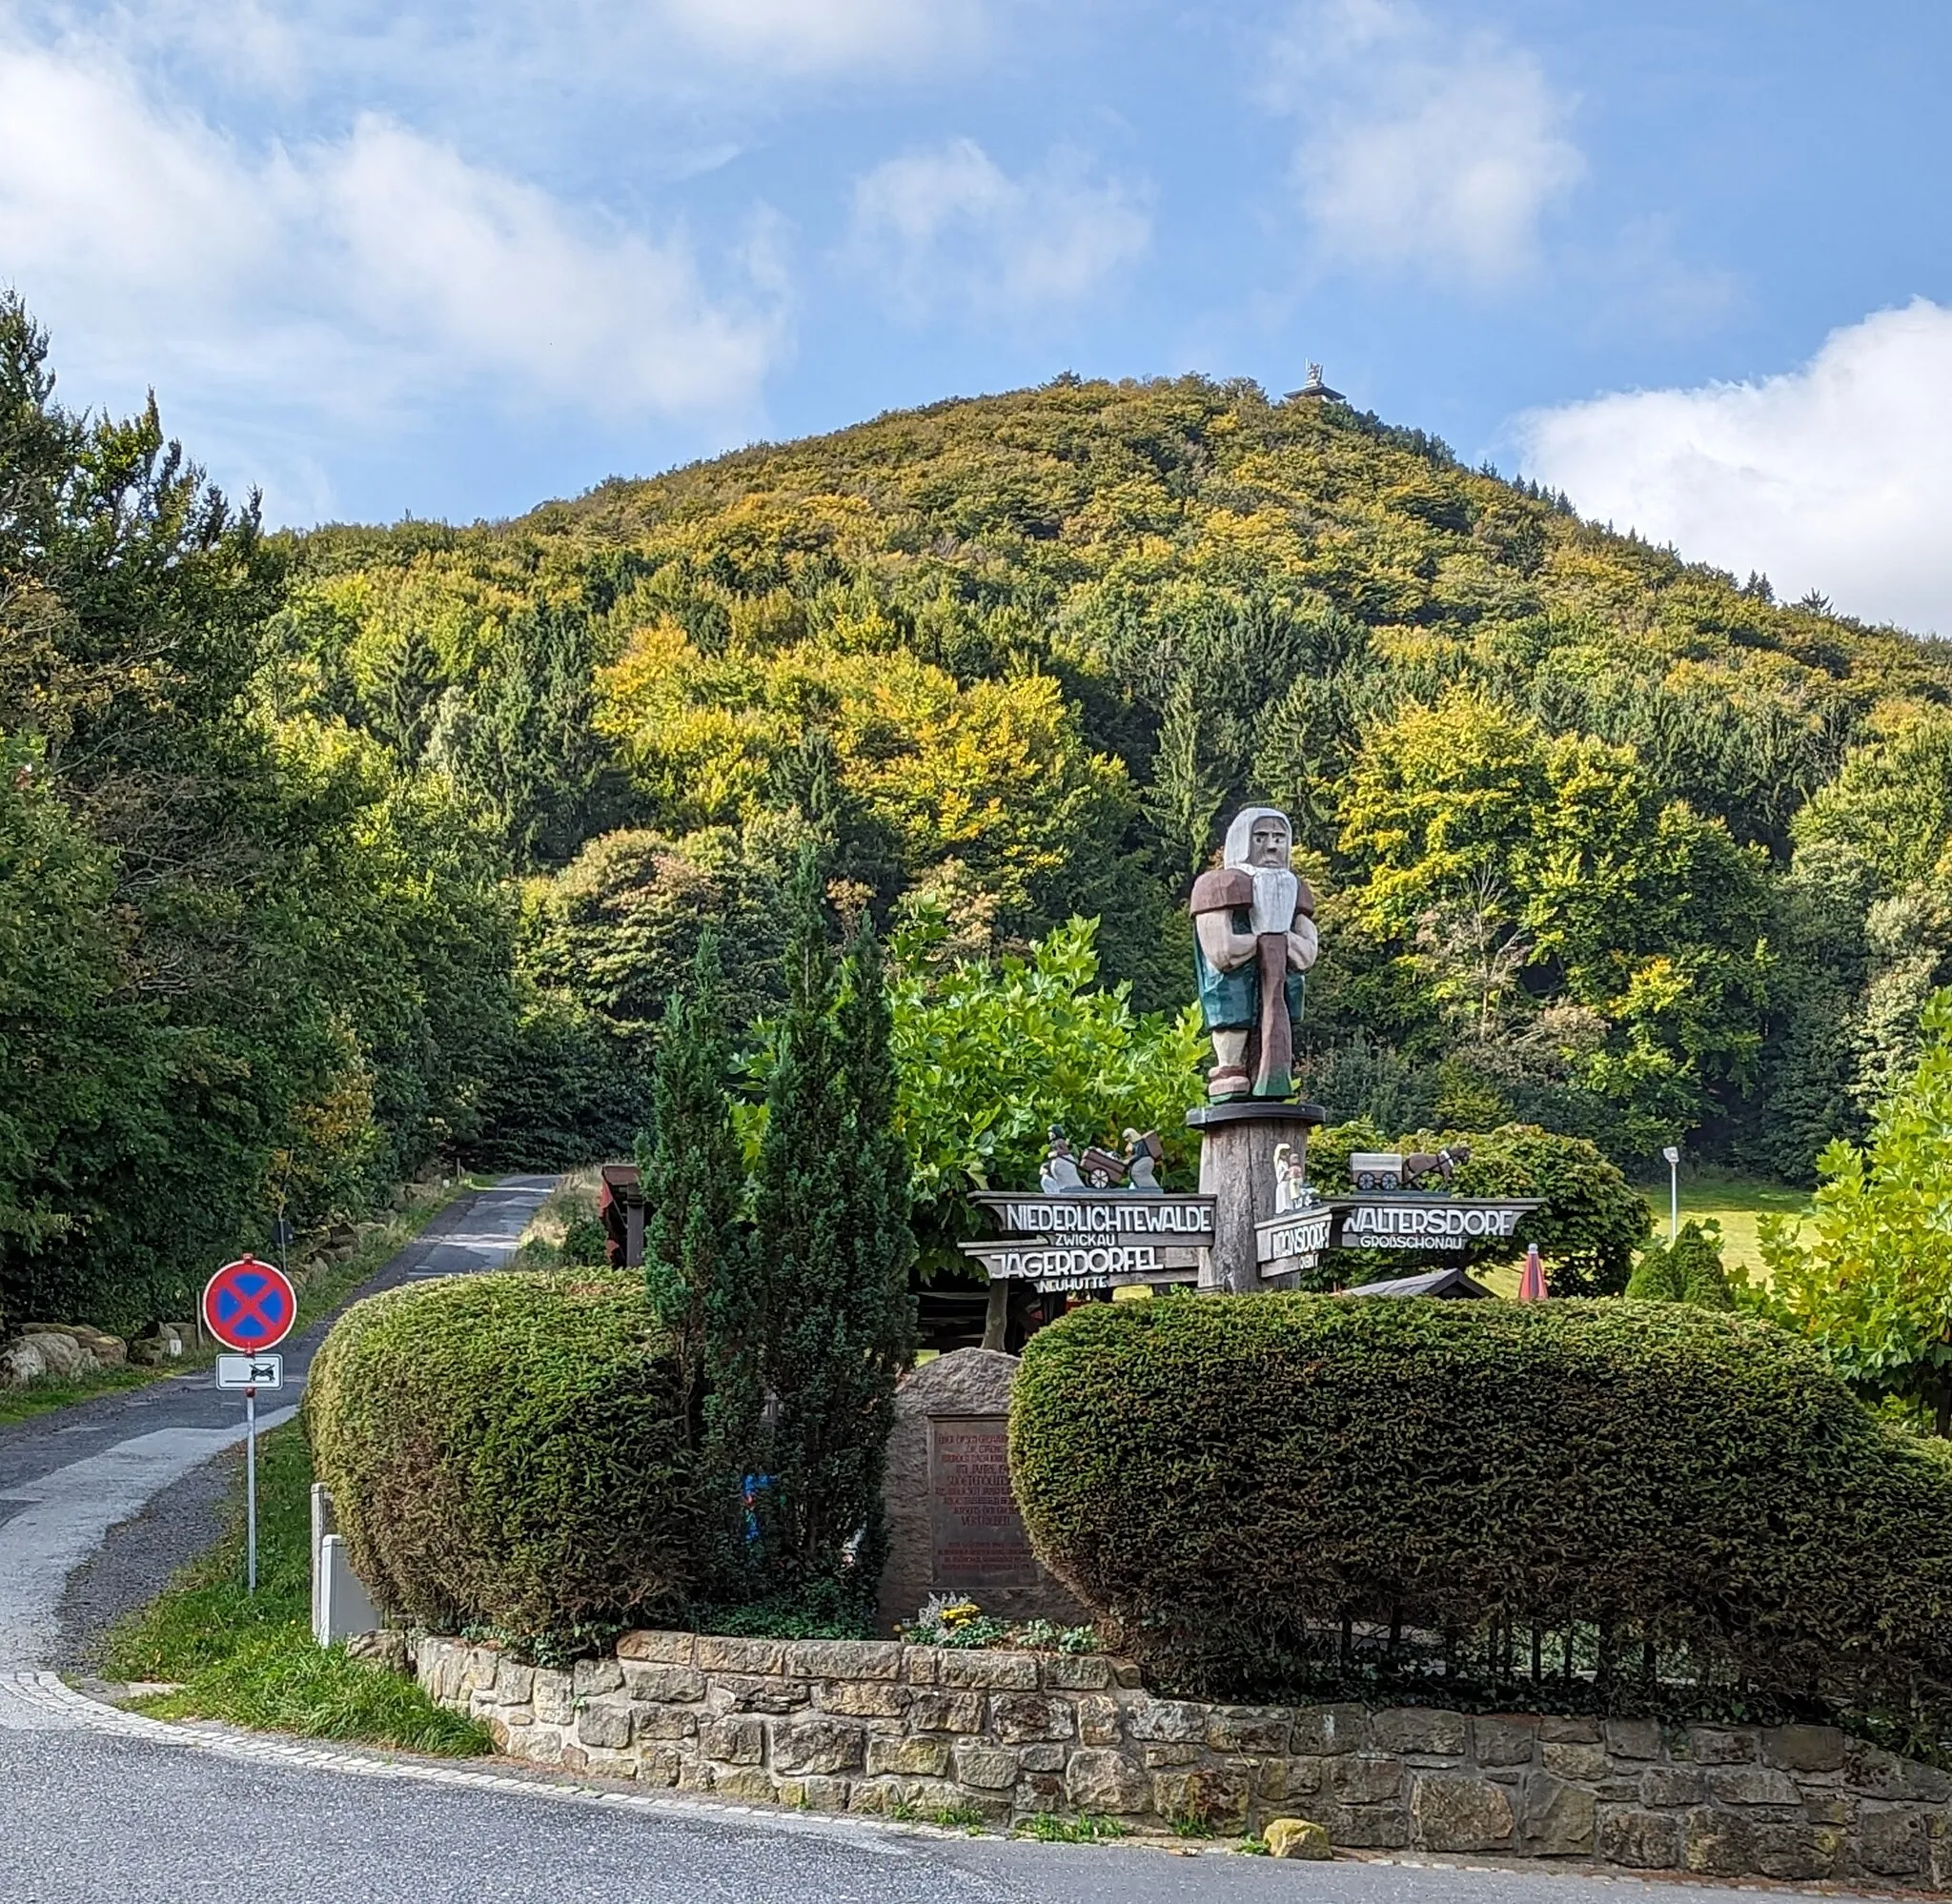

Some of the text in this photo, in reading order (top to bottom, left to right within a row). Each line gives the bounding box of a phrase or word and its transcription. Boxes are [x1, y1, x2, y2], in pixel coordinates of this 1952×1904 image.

[1006, 1205, 1211, 1232] NIEDERLICHTEWALDE
[1342, 1207, 1514, 1236] WALTERSDORF
[1055, 1233, 1115, 1247] ZWICKAU
